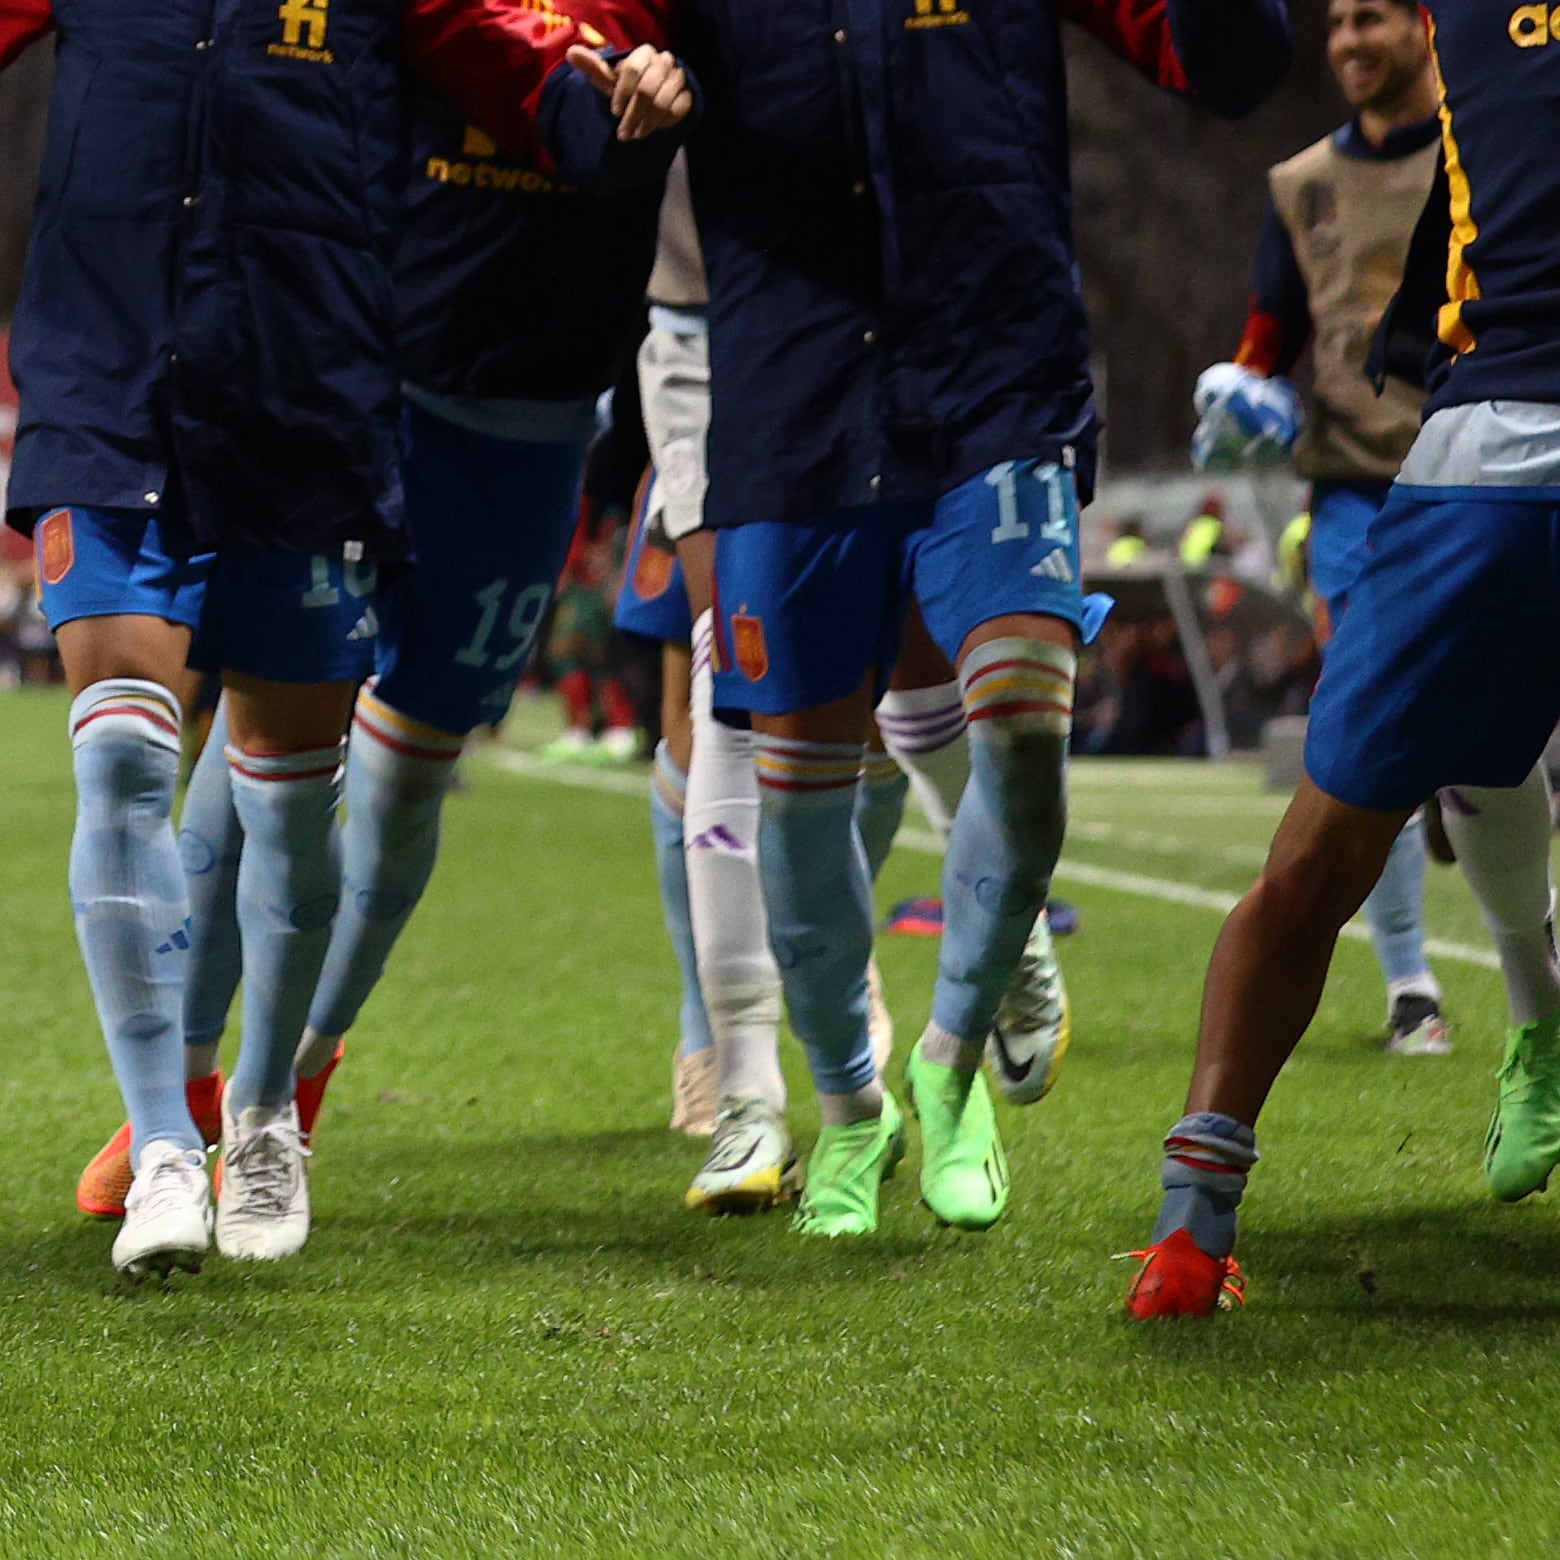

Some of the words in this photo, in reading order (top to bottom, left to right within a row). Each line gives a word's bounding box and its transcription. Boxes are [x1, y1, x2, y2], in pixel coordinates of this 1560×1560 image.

[1507, 2, 1560, 49] a
[984, 459, 1072, 547] 11
[454, 578, 553, 671] 19
